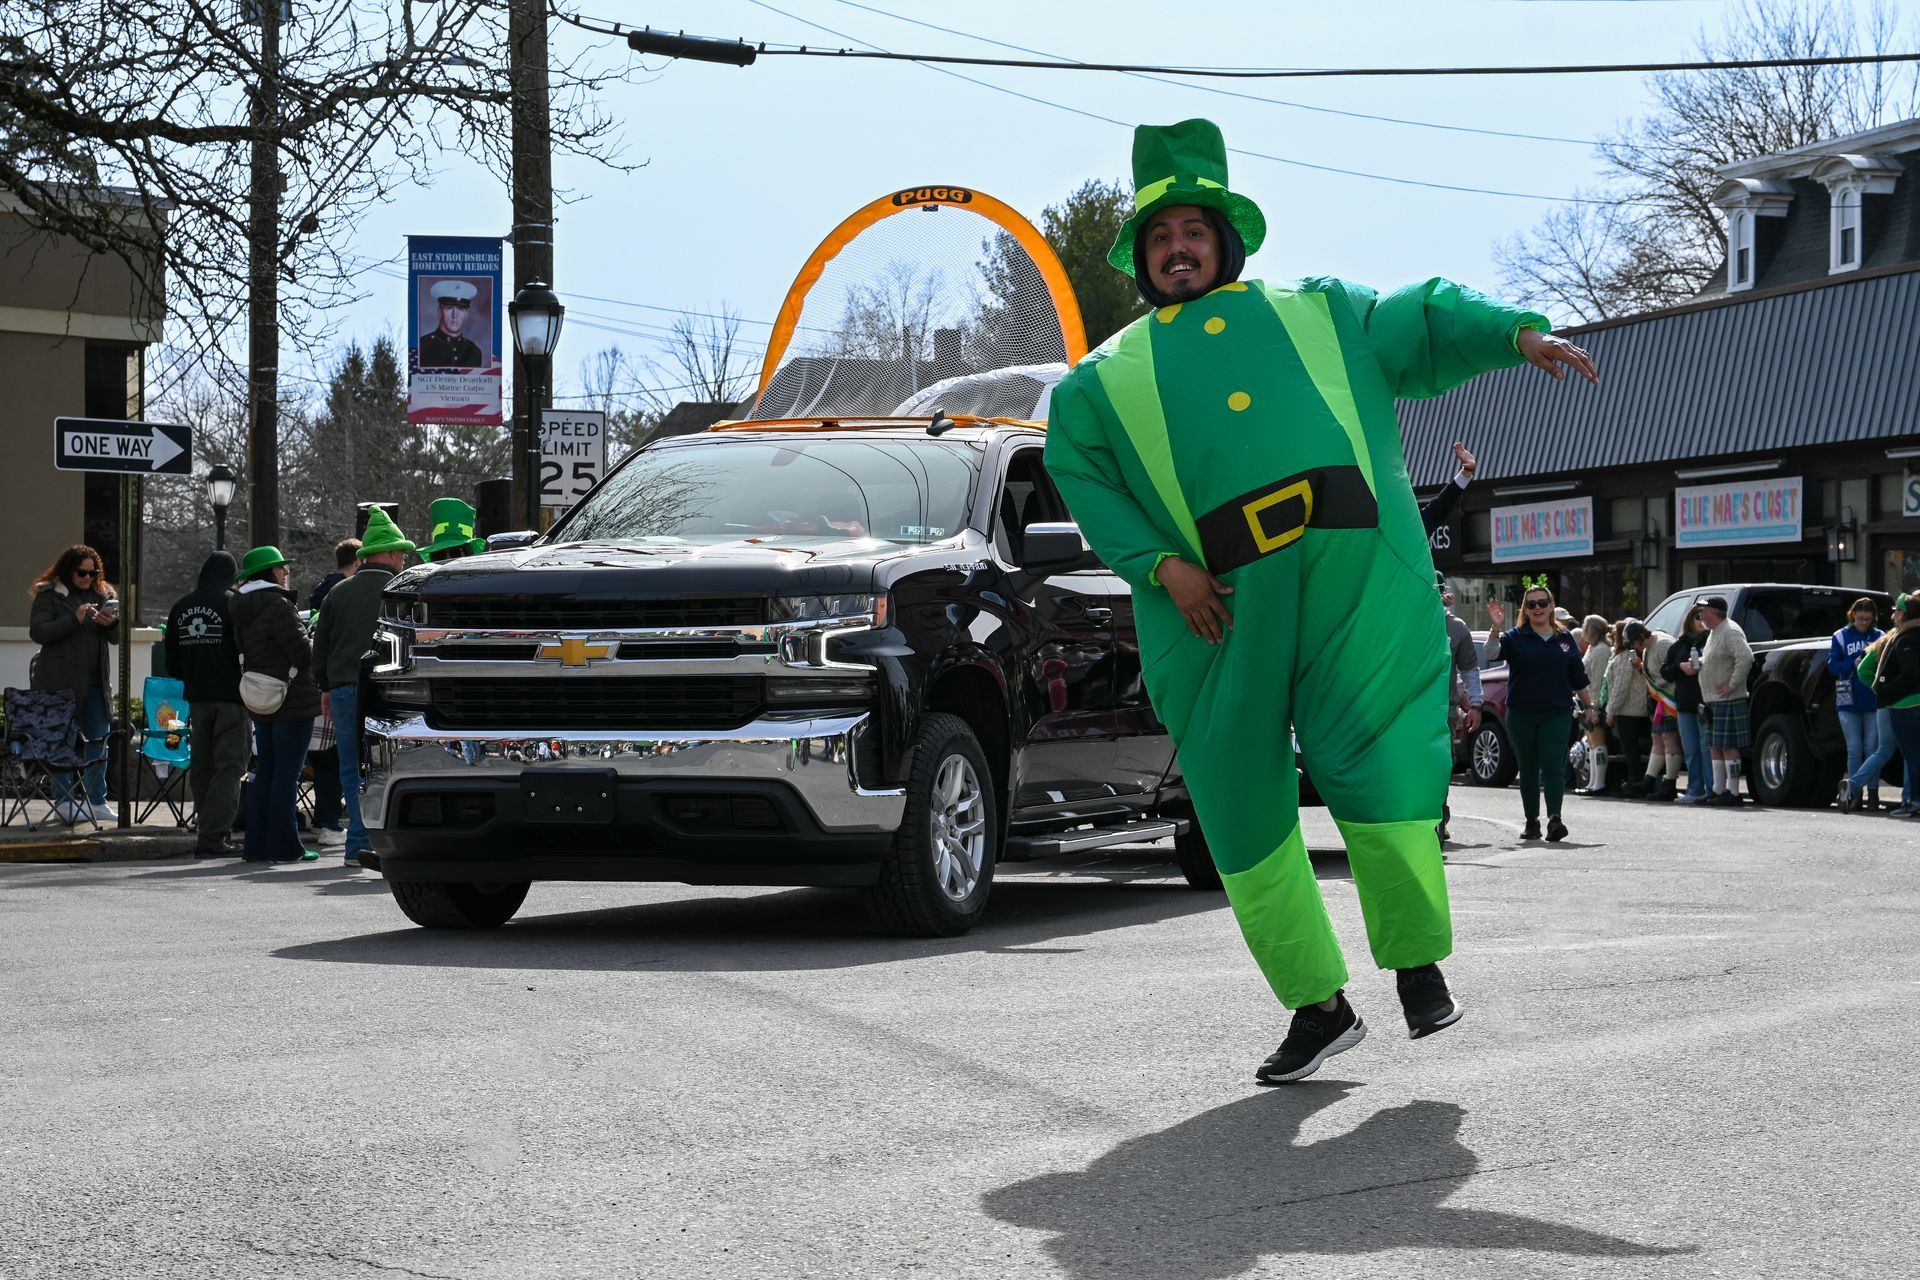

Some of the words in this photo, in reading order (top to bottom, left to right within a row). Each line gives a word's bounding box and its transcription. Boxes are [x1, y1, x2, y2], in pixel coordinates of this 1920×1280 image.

[901, 188, 964, 204] PUGG
[412, 253, 433, 261] EAST
[435, 253, 499, 262] STROUDSBURG
[412, 262, 462, 271] HOMETOWN
[464, 263, 499, 271] HEROES
[71, 434, 111, 456] ONE
[116, 436, 153, 457] WAY
[542, 441, 592, 456] LIMIT
[540, 460, 598, 496] 25
[1681, 495, 1709, 527] ELLIE
[1713, 491, 1750, 525] MAE'S
[1754, 487, 1798, 521] CLOSET
[1554, 506, 1589, 537] CLOSET
[178, 606, 222, 626] CARHARTT
